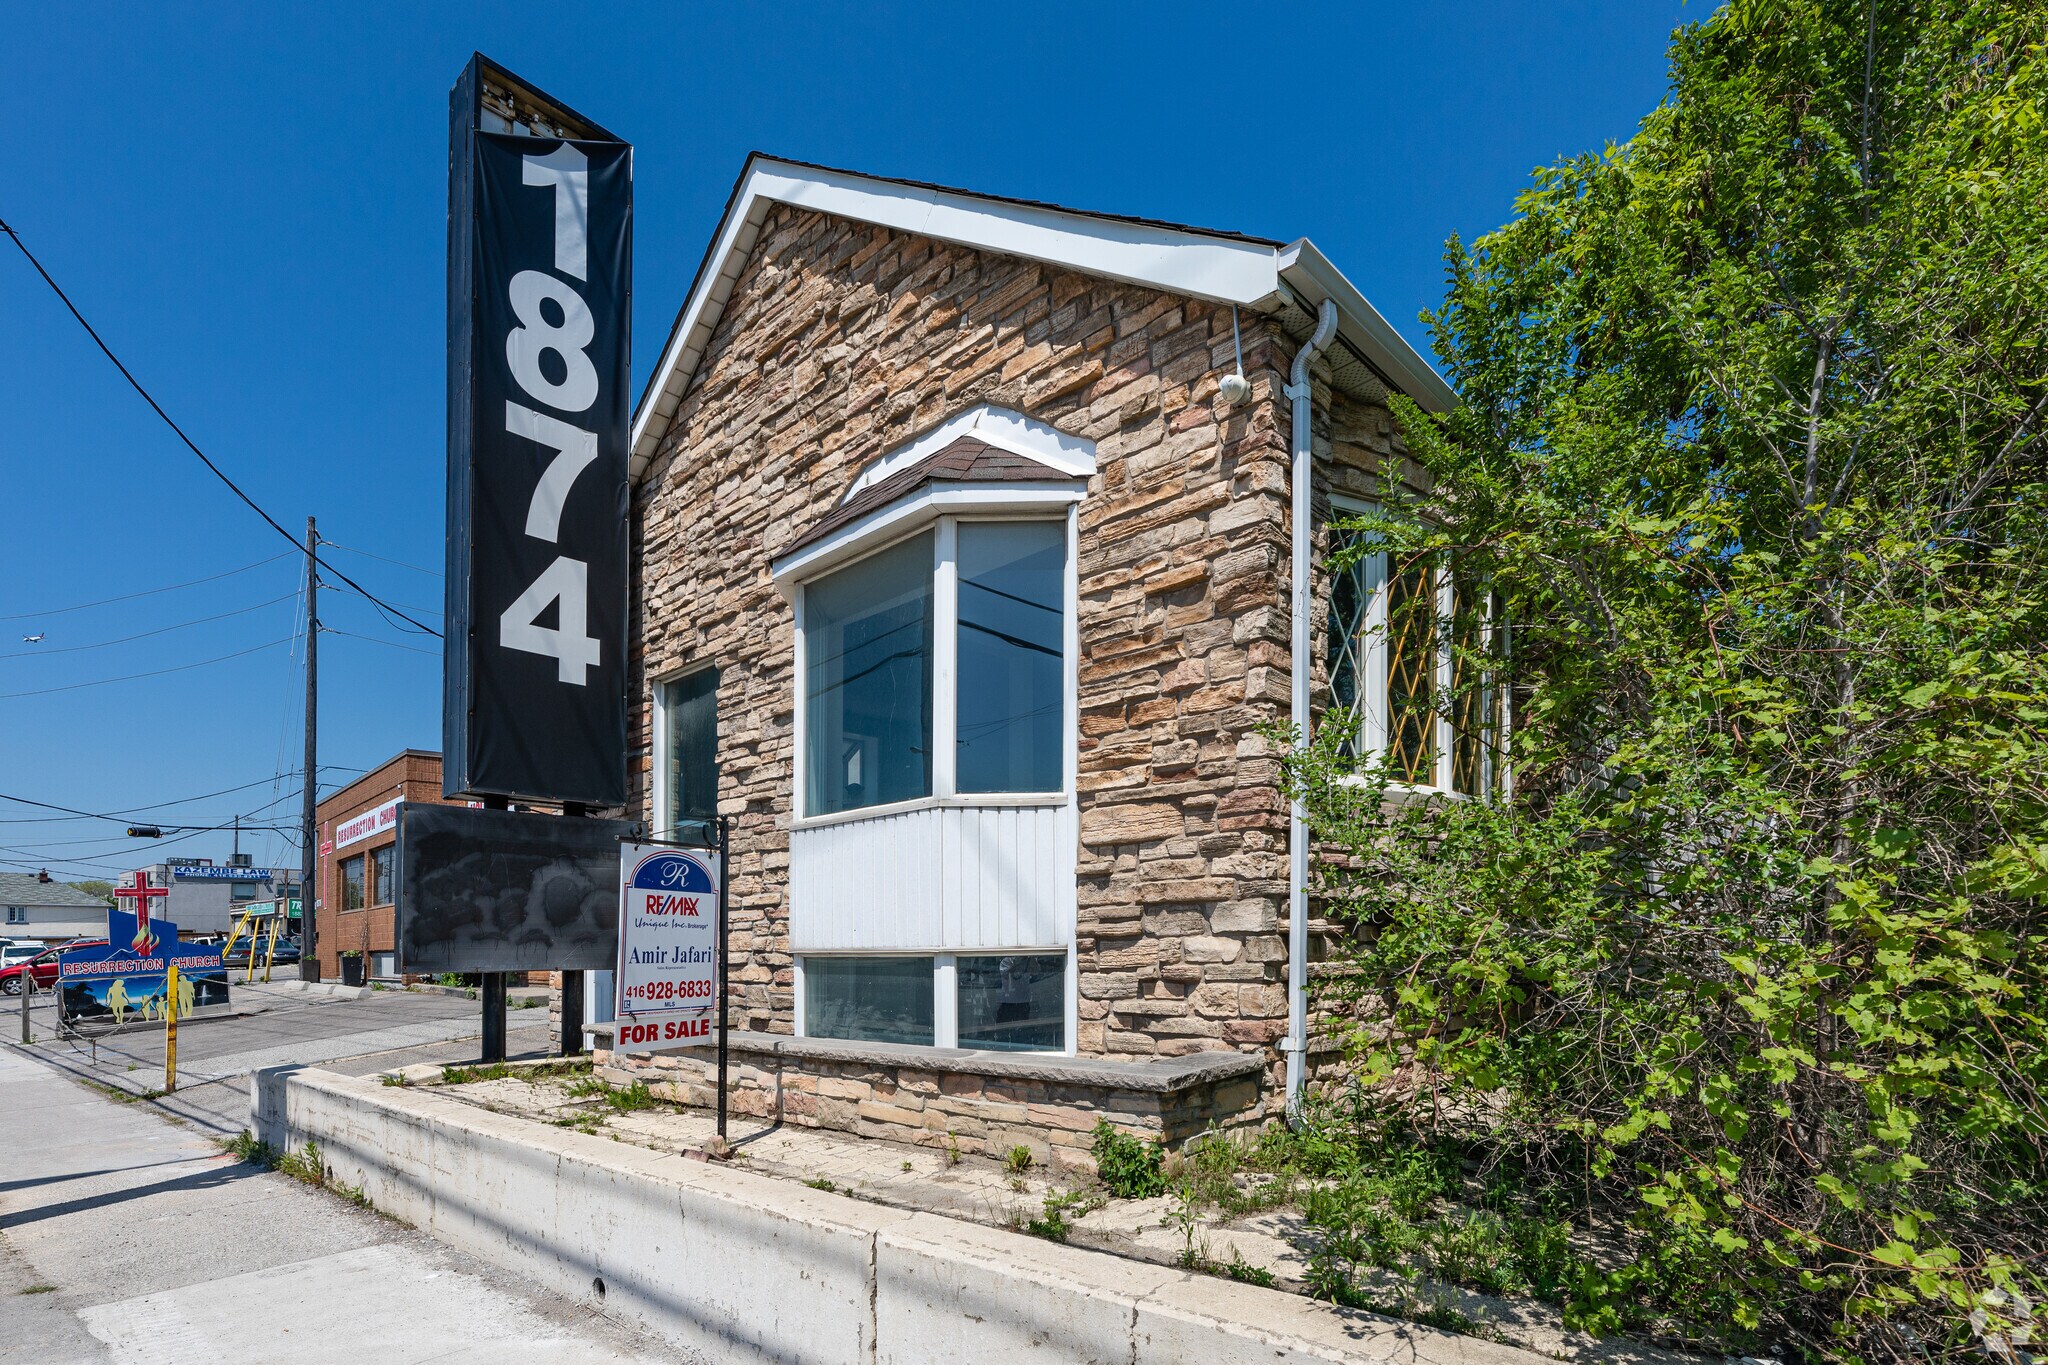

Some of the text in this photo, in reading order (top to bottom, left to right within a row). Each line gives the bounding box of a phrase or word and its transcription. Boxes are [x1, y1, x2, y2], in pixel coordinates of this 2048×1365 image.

[500, 141, 600, 687] 1874
[338, 802, 397, 844] RESURRECTION CHURC
[175, 866, 237, 874] KAZEMBE
[660, 861, 690, 888] R
[645, 894, 700, 917] RE/MAX
[635, 917, 669, 931] Unique
[63, 955, 220, 976] RESURRECTION CHURCH
[629, 946, 711, 964] Amir Jafari
[626, 979, 711, 1001] 416 928-6833
[619, 1018, 710, 1046] FOR SALE
